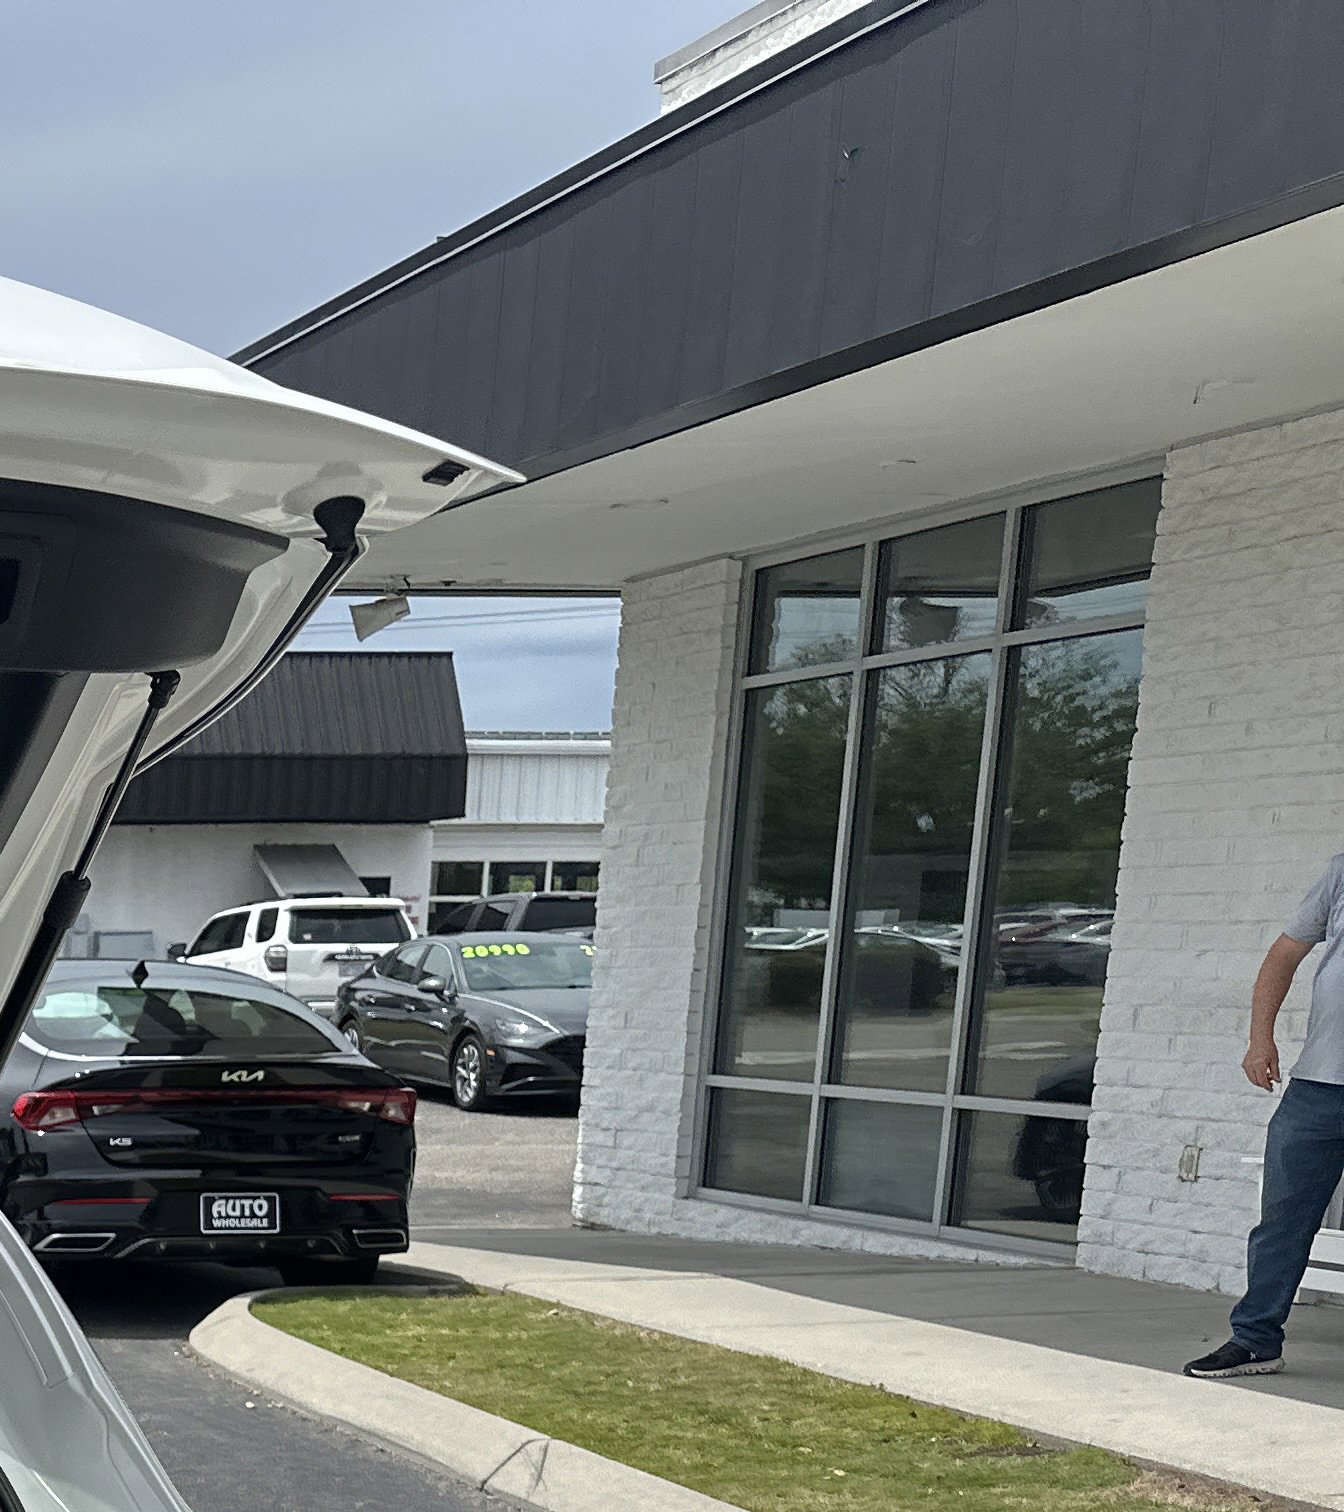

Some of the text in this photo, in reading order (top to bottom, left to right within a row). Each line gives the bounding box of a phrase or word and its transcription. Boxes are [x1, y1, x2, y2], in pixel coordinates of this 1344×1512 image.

[462, 943, 530, 958] 20990
[212, 1199, 268, 1217] AUTO
[212, 1218, 269, 1228] WHOLESALE
